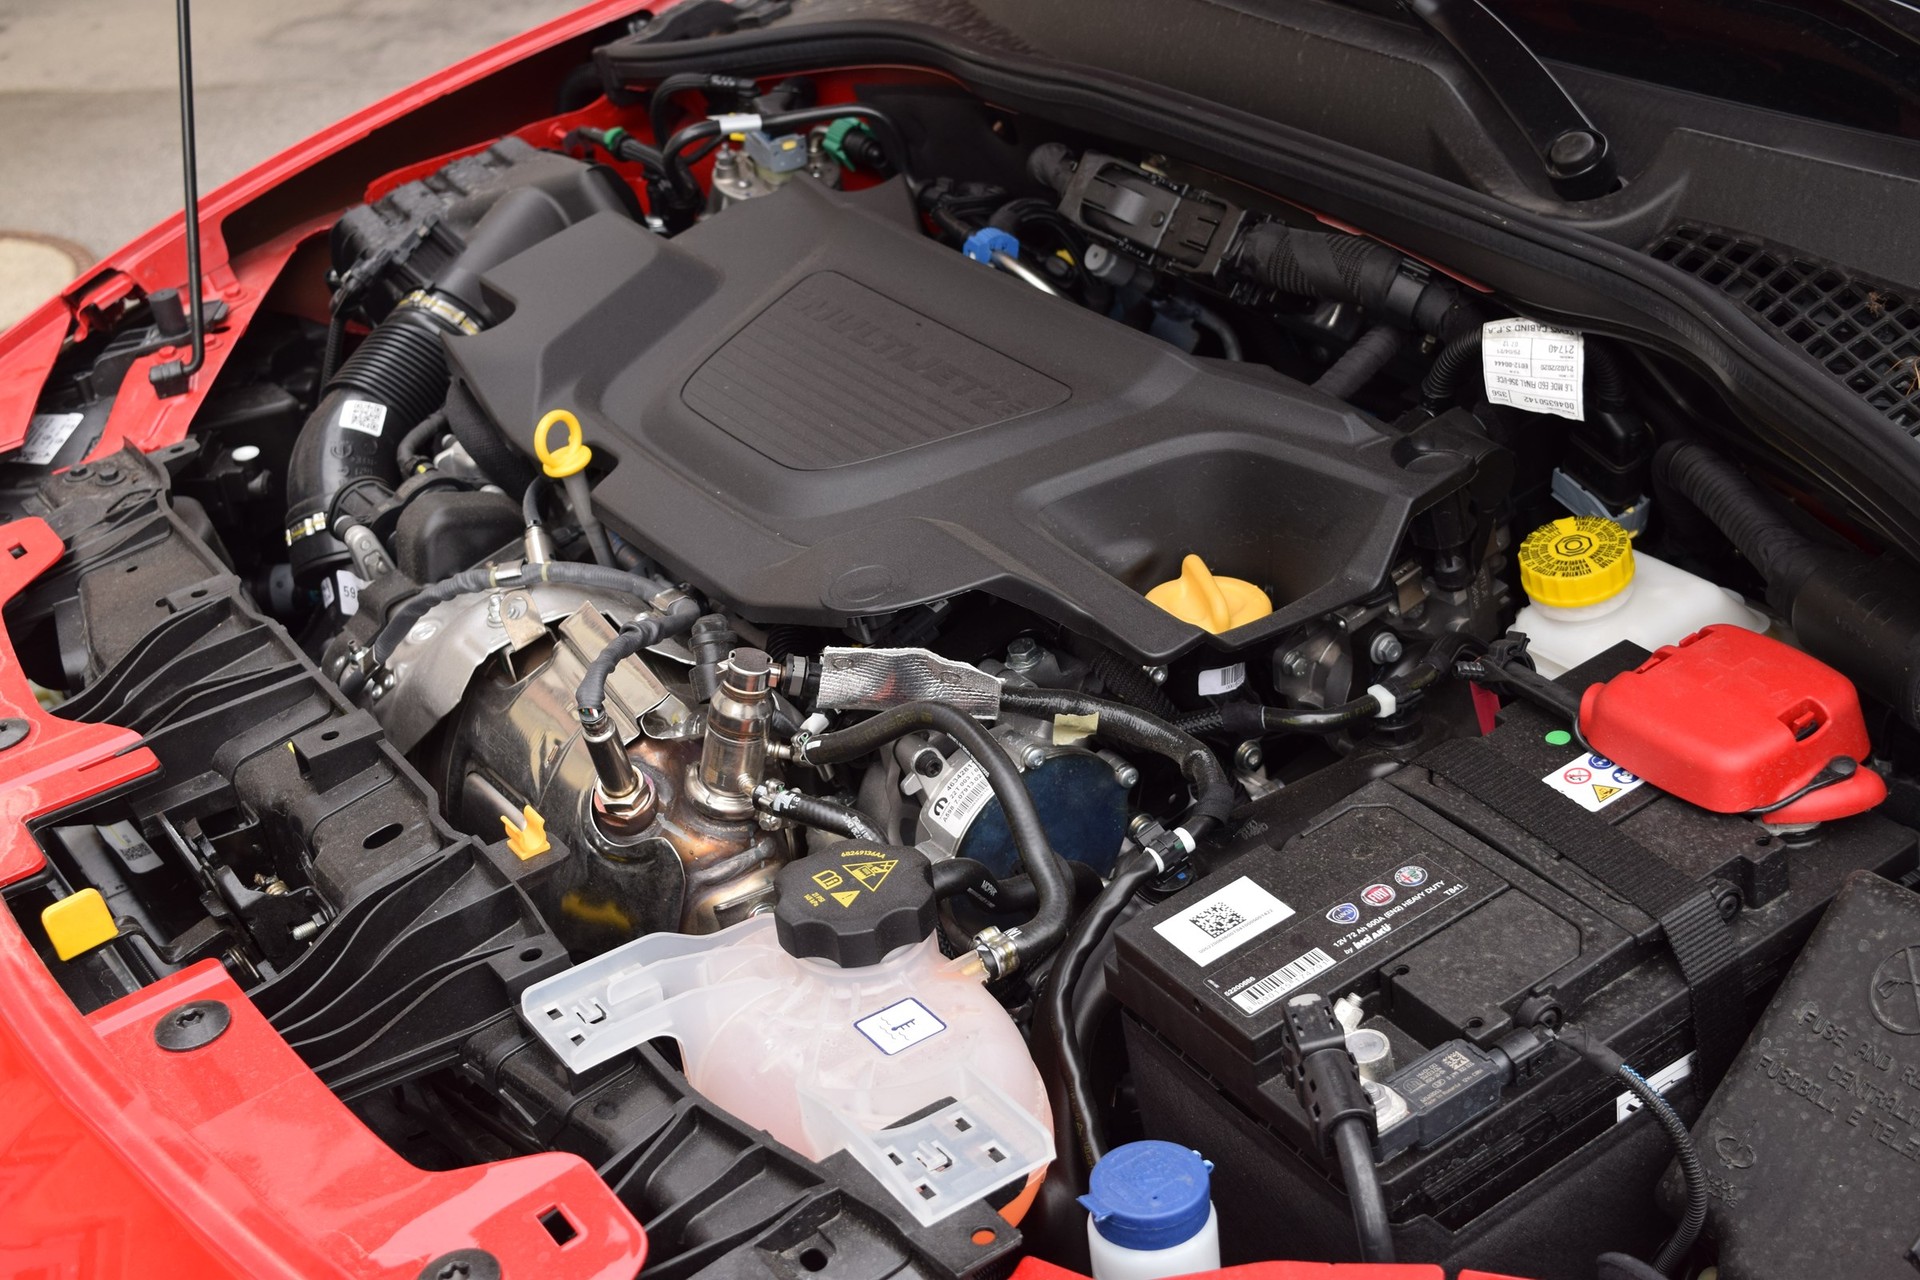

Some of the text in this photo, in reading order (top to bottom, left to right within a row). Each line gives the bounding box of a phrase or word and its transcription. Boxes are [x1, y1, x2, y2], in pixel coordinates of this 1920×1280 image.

[1548, 344, 1574, 354] 21740
[343, 586, 356, 599] 59
[946, 760, 974, 791] 4634281
[1368, 888, 1390, 902] FIAT
[1332, 938, 1348, 948] 12V
[1346, 931, 1357, 940] 72
[1357, 926, 1368, 935] Ah
[1402, 892, 1426, 908] HEAVY
[1424, 880, 1446, 894] DUTY
[1344, 946, 1354, 955] by
[1798, 1009, 1849, 1048] FUSE
[1854, 1041, 1894, 1072] AND
[1754, 1054, 1840, 1114] FUSIBILI
[1846, 1105, 1866, 1127] E
